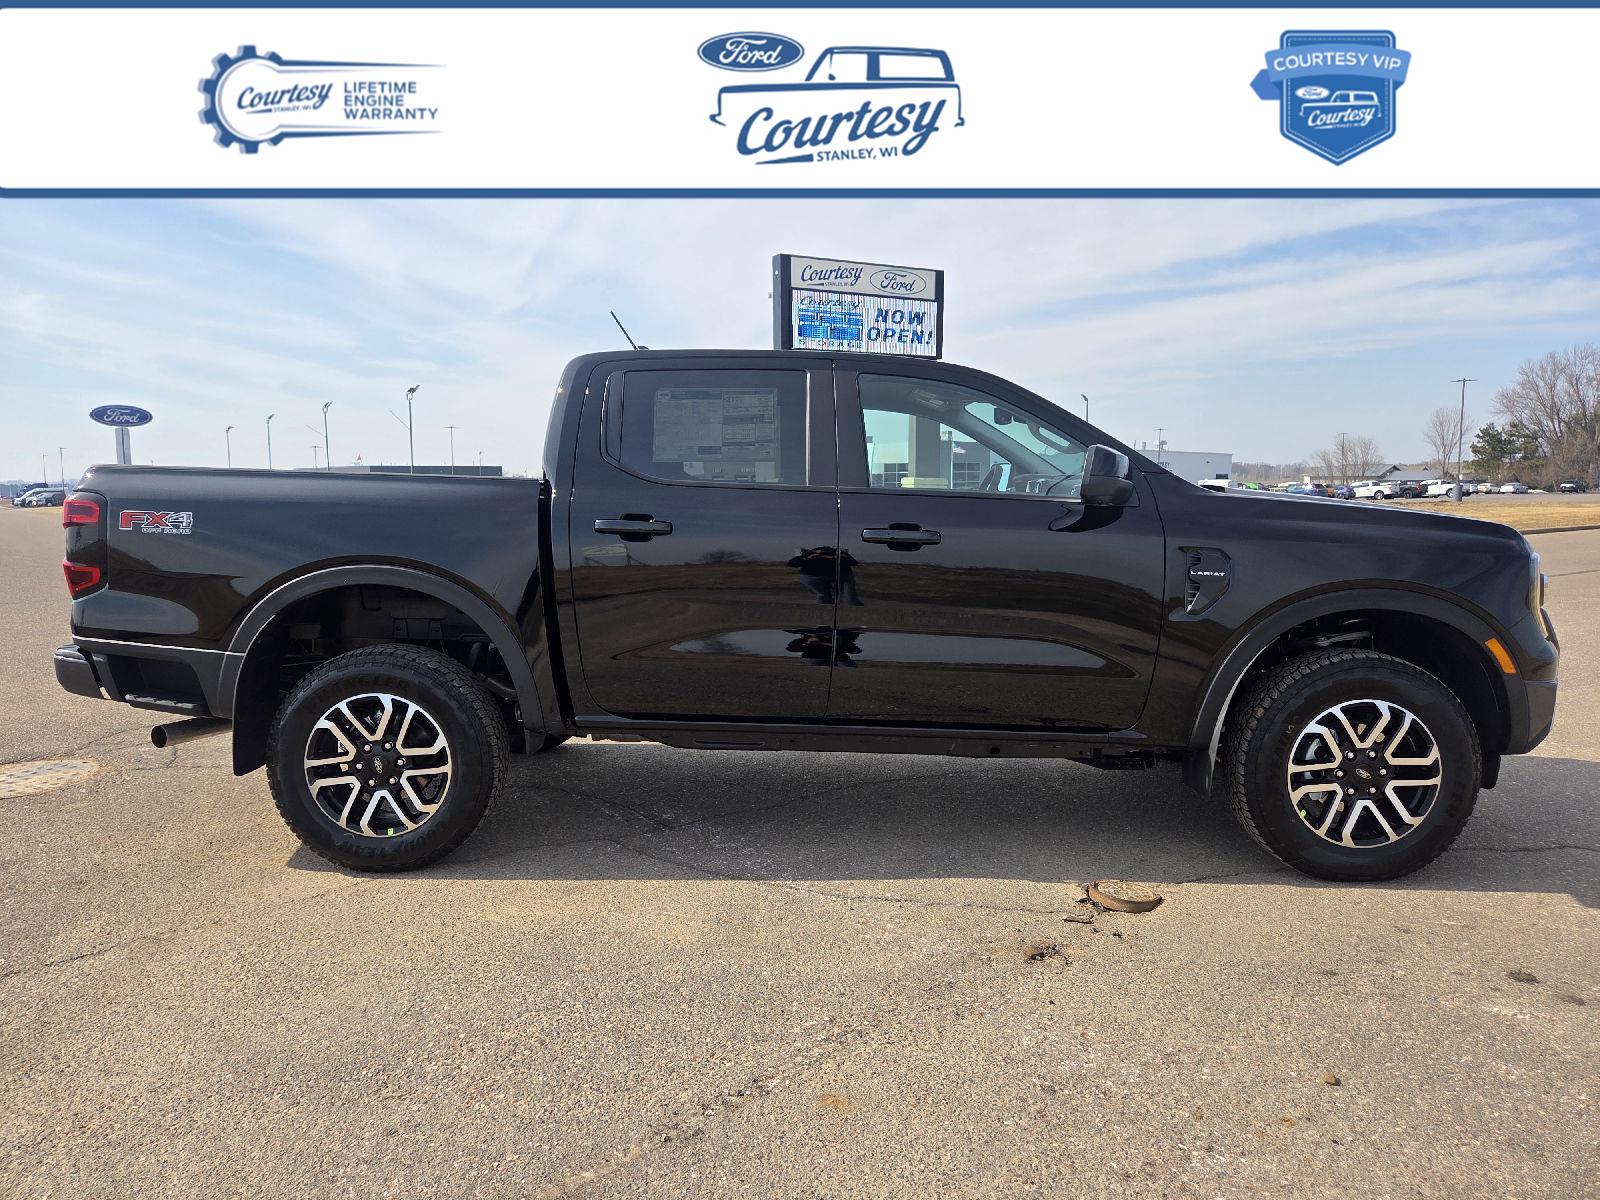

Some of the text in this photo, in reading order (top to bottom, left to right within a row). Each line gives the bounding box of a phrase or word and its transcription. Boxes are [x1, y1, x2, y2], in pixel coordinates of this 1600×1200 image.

[800, 264, 916, 293] Courtesy Ford
[875, 308, 927, 326] NOW
[867, 326, 933, 345] OPEN!
[104, 408, 139, 423] Ford
[119, 510, 193, 530] FX4
